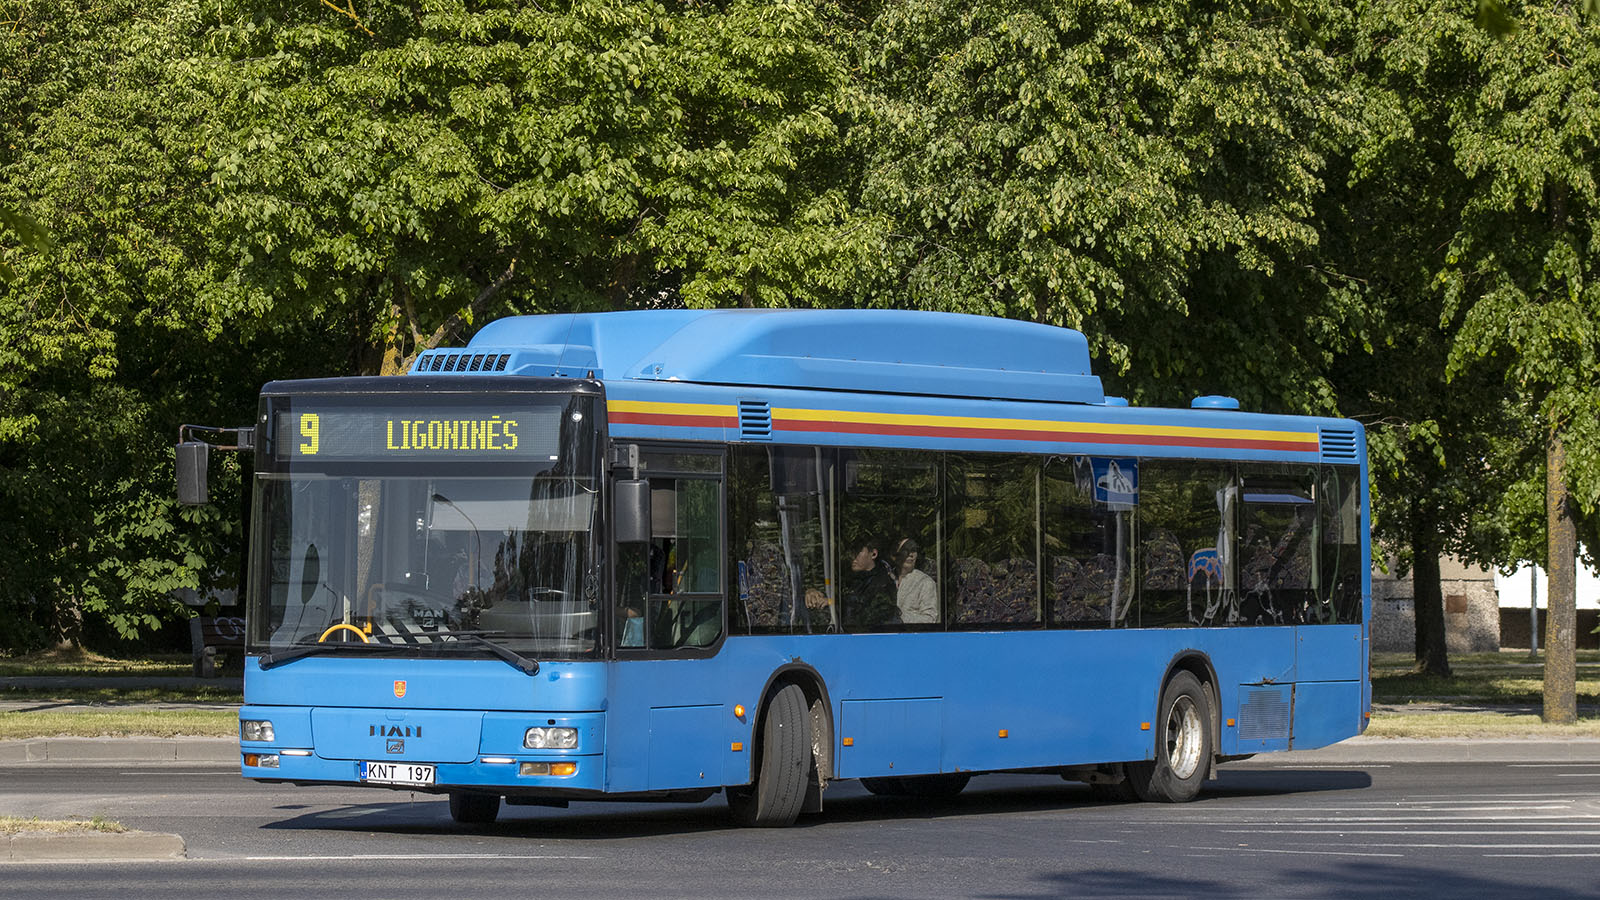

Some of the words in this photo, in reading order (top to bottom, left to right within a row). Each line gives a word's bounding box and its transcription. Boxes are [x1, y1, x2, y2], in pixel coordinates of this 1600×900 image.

[300, 413, 319, 455] 9
[413, 609, 444, 618] MAN
[369, 725, 422, 738] MAN
[368, 763, 397, 779] KNT
[408, 766, 432, 781] 197
